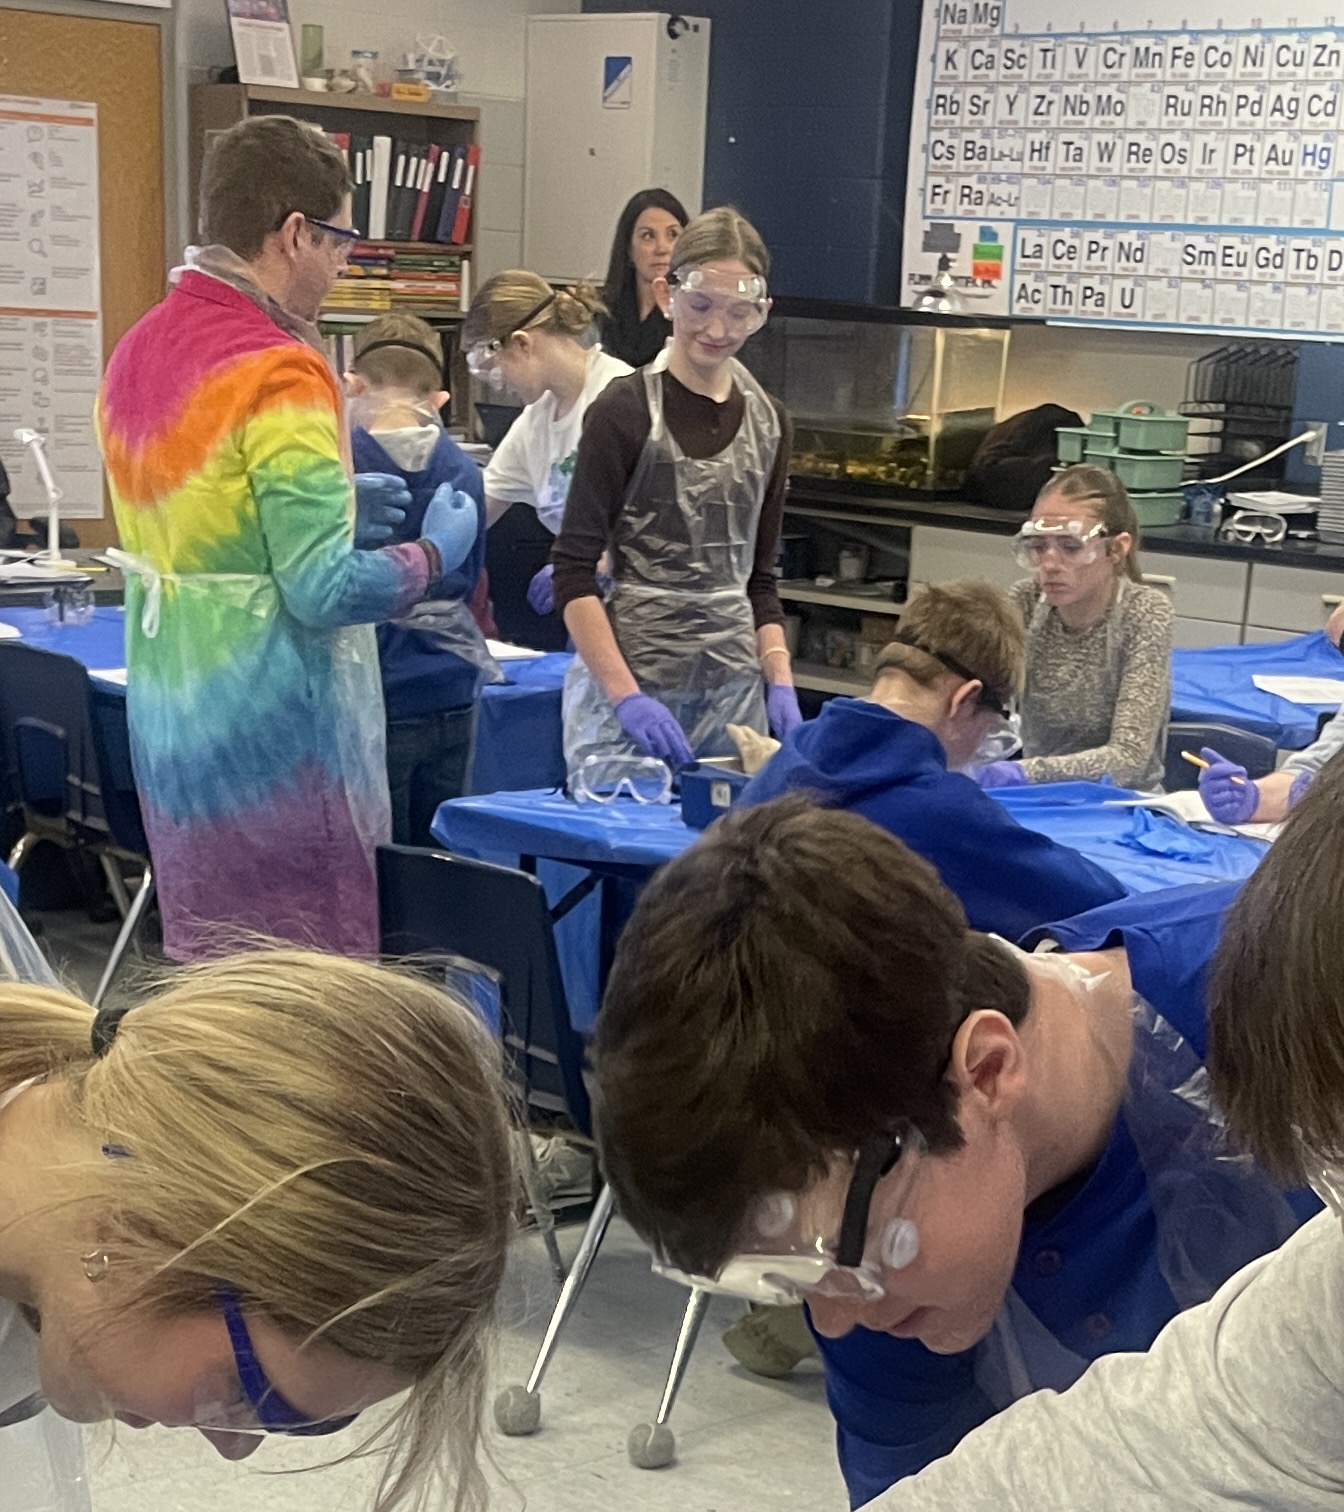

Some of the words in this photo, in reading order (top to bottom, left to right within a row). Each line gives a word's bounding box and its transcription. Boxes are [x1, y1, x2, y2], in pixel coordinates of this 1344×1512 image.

[942, 2, 967, 24] Na
[972, 2, 1001, 27] Mg
[944, 48, 958, 70] K
[970, 48, 995, 70] Ca
[1002, 48, 1027, 70] Sc
[1039, 47, 1056, 69] Ti
[1074, 46, 1088, 69] V
[1102, 46, 1126, 69] Cr
[1132, 46, 1162, 68] Mn
[1170, 45, 1194, 68] Fe
[1203, 45, 1232, 68] Co
[1242, 44, 1265, 67] Ni
[1275, 44, 1304, 67] Cu
[1312, 43, 1340, 67] Zn
[933, 93, 960, 115] Rb
[968, 94, 990, 116] Sr
[1005, 93, 1018, 115] Y
[1032, 94, 1054, 116] Zr
[1062, 94, 1090, 116] Nb
[1094, 94, 1125, 116] Mo
[1164, 94, 1192, 116] Ru
[1199, 94, 1226, 116] Rh
[1235, 94, 1263, 117] Pd
[1269, 93, 1299, 120] Ag
[1307, 93, 1337, 117] Cd
[931, 139, 955, 160] Cs
[963, 139, 987, 161] Ba
[1028, 140, 1051, 161] Hf
[1061, 140, 1083, 162] Ta
[1096, 140, 1116, 162] W
[1126, 141, 1152, 163] Re
[1160, 141, 1187, 164] Os
[1201, 142, 1216, 164] Ir
[1233, 142, 1254, 165] Pt
[1264, 143, 1293, 166] Au
[1301, 143, 1331, 170] Hg
[930, 184, 950, 204] Fr
[959, 184, 983, 205] Ra
[1020, 237, 1043, 259] La
[1052, 238, 1077, 260] Ce
[1086, 240, 1108, 261] Pr
[1117, 241, 1145, 263] Nd
[1181, 243, 1216, 266] Sm
[1221, 245, 1247, 267] Eu
[1254, 246, 1284, 269] Gd
[1292, 247, 1318, 270] Tb
[1015, 282, 1041, 304] Ac
[1049, 284, 1072, 305] Th
[1081, 285, 1104, 307] Pa
[1120, 287, 1134, 309] U
